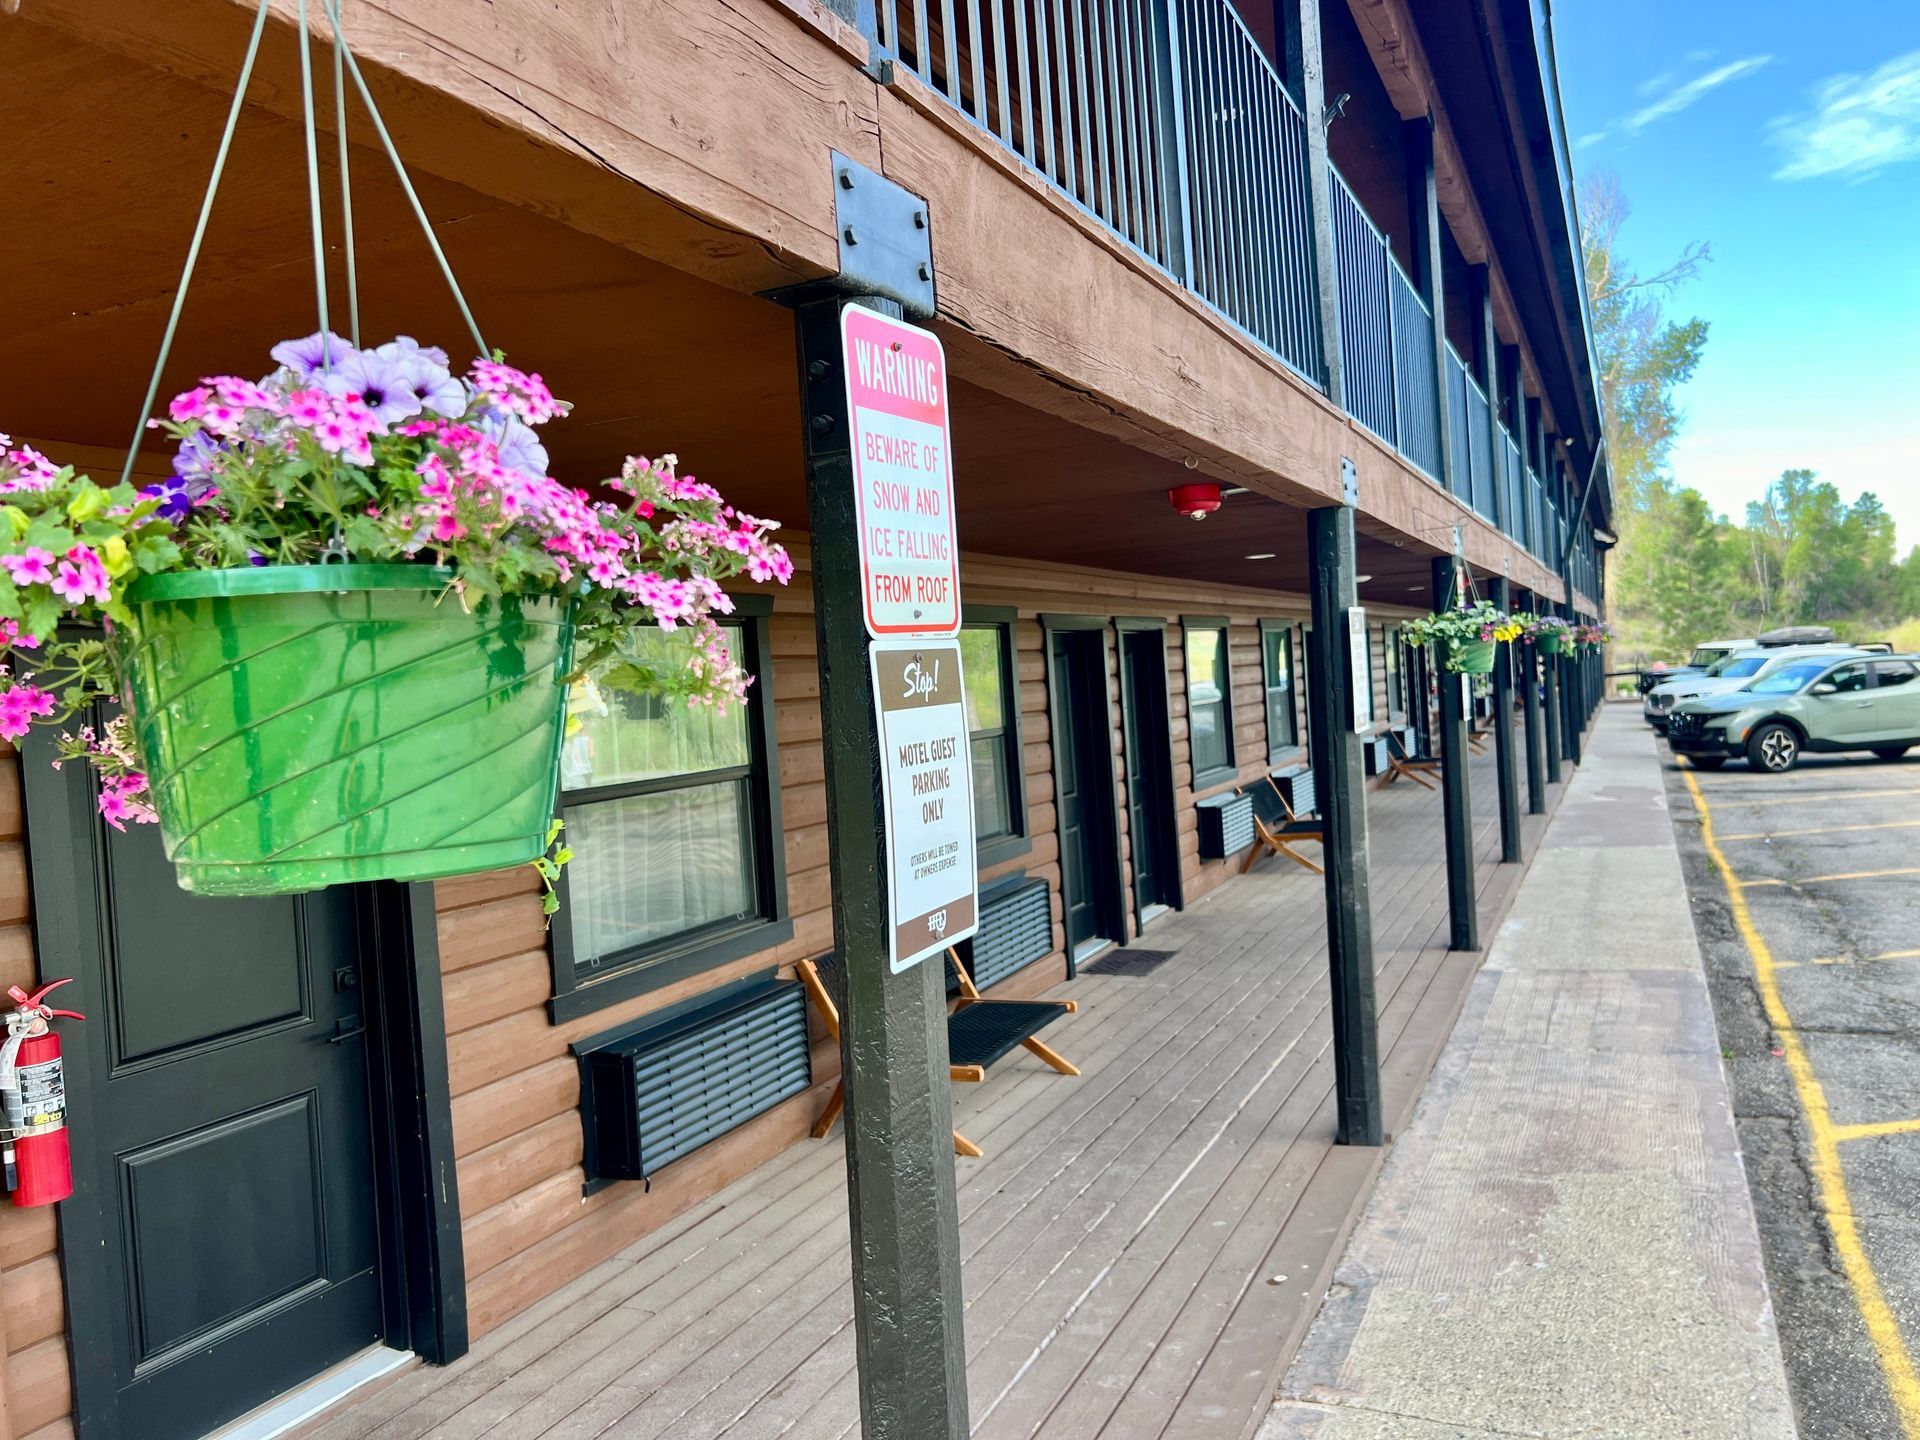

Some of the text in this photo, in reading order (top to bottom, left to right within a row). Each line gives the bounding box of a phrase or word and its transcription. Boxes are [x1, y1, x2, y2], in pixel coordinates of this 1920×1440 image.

[855, 337, 937, 407] WARNING
[865, 432, 939, 473] BEWARE OF
[873, 480, 940, 516] SNOW AND
[869, 526, 948, 561] ICE FALLING
[875, 574, 948, 604] FROM ROOF
[903, 659, 939, 702] Stop!
[899, 736, 956, 768] MOTEL GUEST
[912, 767, 950, 797] PARKING
[922, 797, 944, 825] ONLY
[911, 841, 959, 867] OTHERS WILL BE TOWED
[938, 855, 957, 872] EXPENSE
